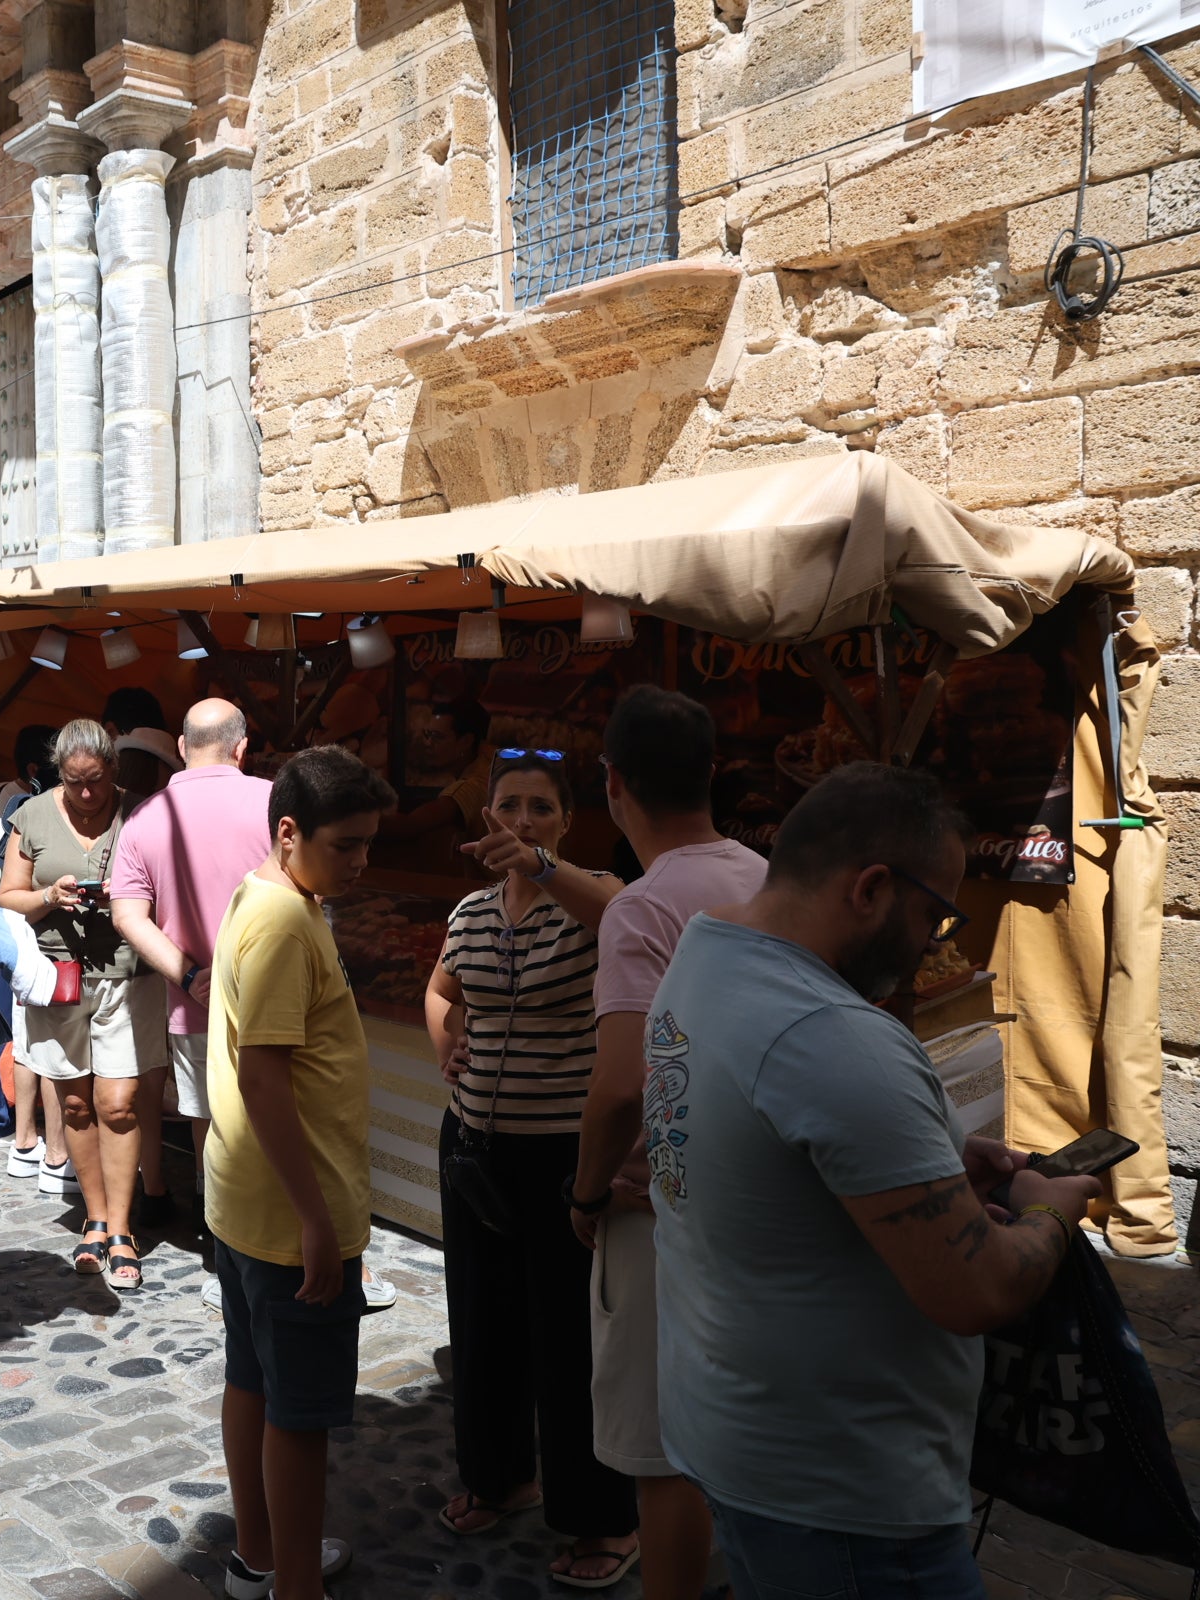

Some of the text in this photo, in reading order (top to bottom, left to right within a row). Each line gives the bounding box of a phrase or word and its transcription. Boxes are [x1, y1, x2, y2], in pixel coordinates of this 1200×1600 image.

[1069, 2, 1154, 40] arquitectos
[407, 630, 529, 673] Chote
[689, 627, 941, 685] Bakava
